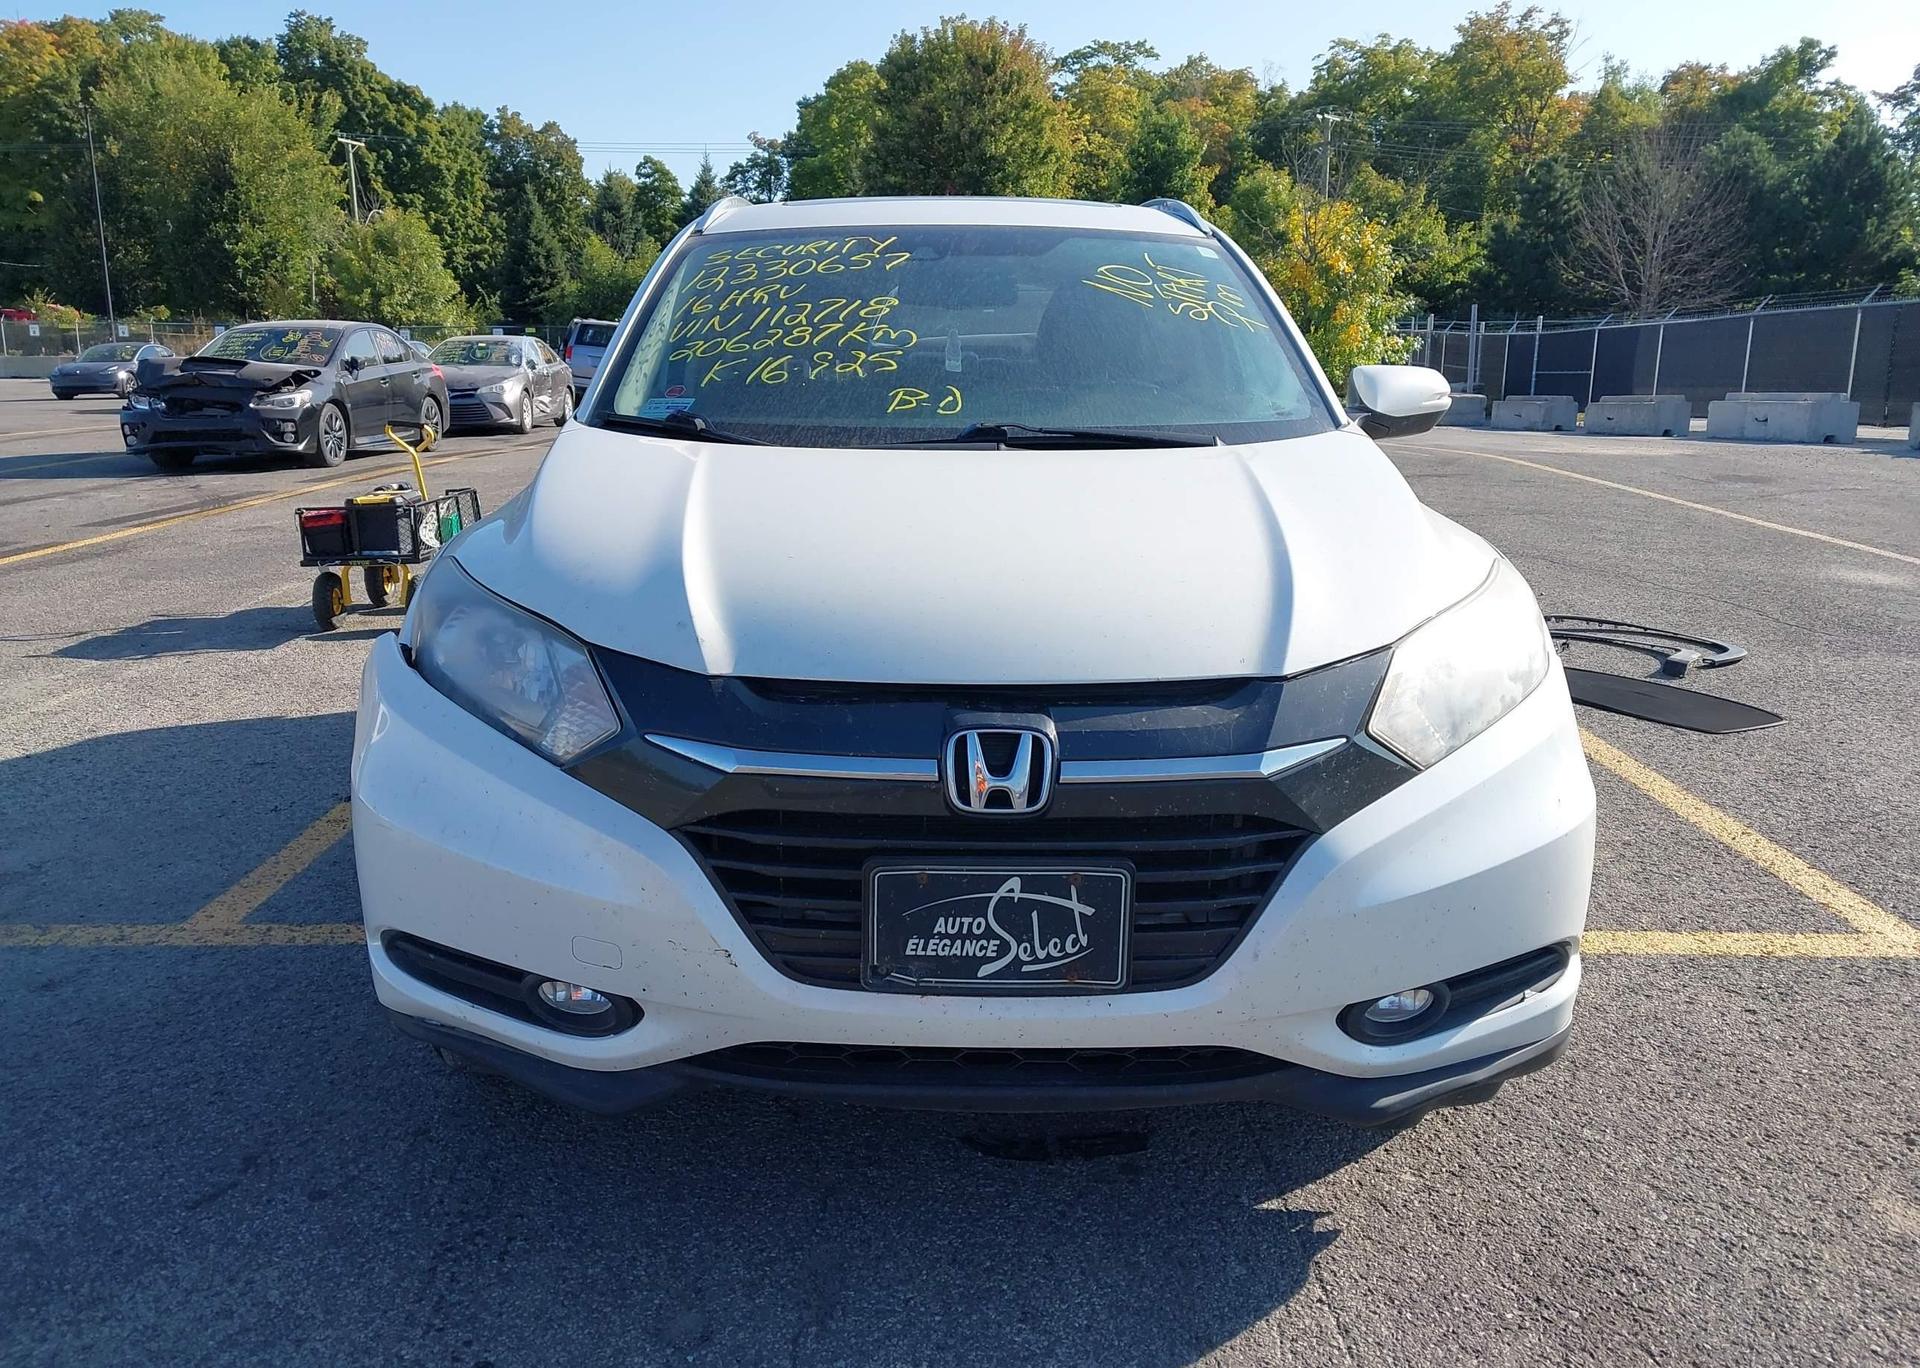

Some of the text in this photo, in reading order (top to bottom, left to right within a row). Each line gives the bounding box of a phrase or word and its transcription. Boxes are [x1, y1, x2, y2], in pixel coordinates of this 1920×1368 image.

[704, 236, 898, 266] SECURITY
[682, 252, 912, 293] 12330657
[1081, 264, 1155, 309] NO
[669, 296, 899, 342] VIN 112718
[674, 284, 807, 320] 16 HRV
[933, 917, 987, 935] AUTO
[976, 876, 1096, 978] Select
[904, 935, 1000, 957] ÉLÉGANCE
